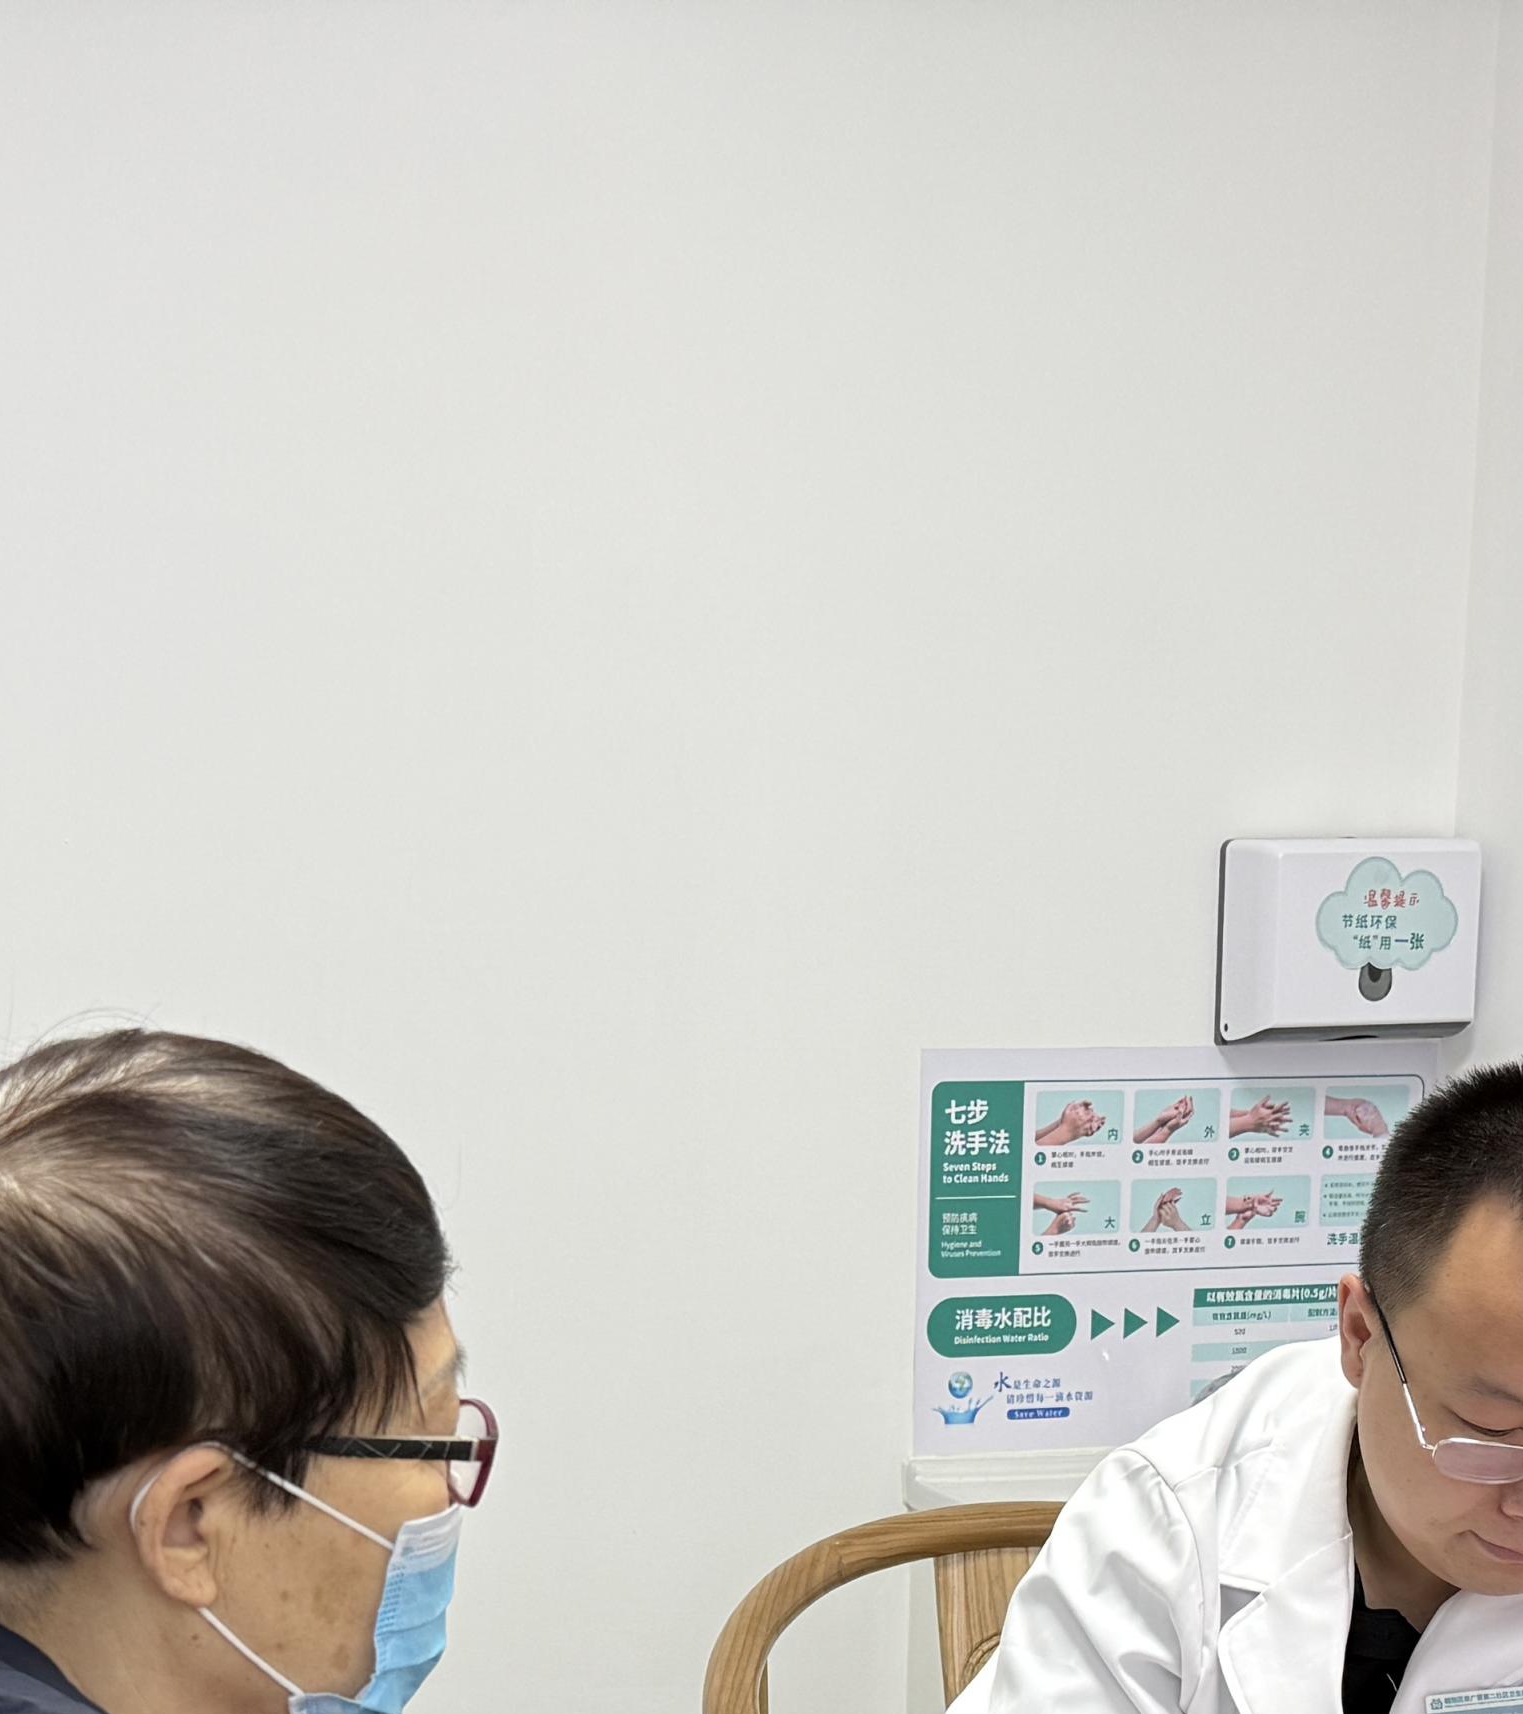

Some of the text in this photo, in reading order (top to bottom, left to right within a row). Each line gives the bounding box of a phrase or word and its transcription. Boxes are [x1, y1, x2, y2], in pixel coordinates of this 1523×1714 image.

[1364, 888, 1420, 909] 温馨提示
[1341, 914, 1397, 930] 节纸环保
[945, 1099, 989, 1124] 七步
[1108, 1128, 1118, 1140] 内
[1204, 1125, 1214, 1138] 外
[1299, 1124, 1310, 1136] 夹
[944, 1130, 1010, 1155] 洗手法
[943, 1162, 997, 1172] Seven Steps
[943, 1173, 1009, 1184] to Clean Hands
[1105, 1216, 1116, 1229] 大
[1200, 1214, 1211, 1225] 立
[942, 1225, 977, 1235] 保持卫生
[941, 1240, 982, 1251] Hygiene and
[955, 1306, 1052, 1331] 消毒水配比
[954, 1333, 1049, 1344] Disinfection Water Ratio
[1014, 1408, 1063, 1418] Save Water
